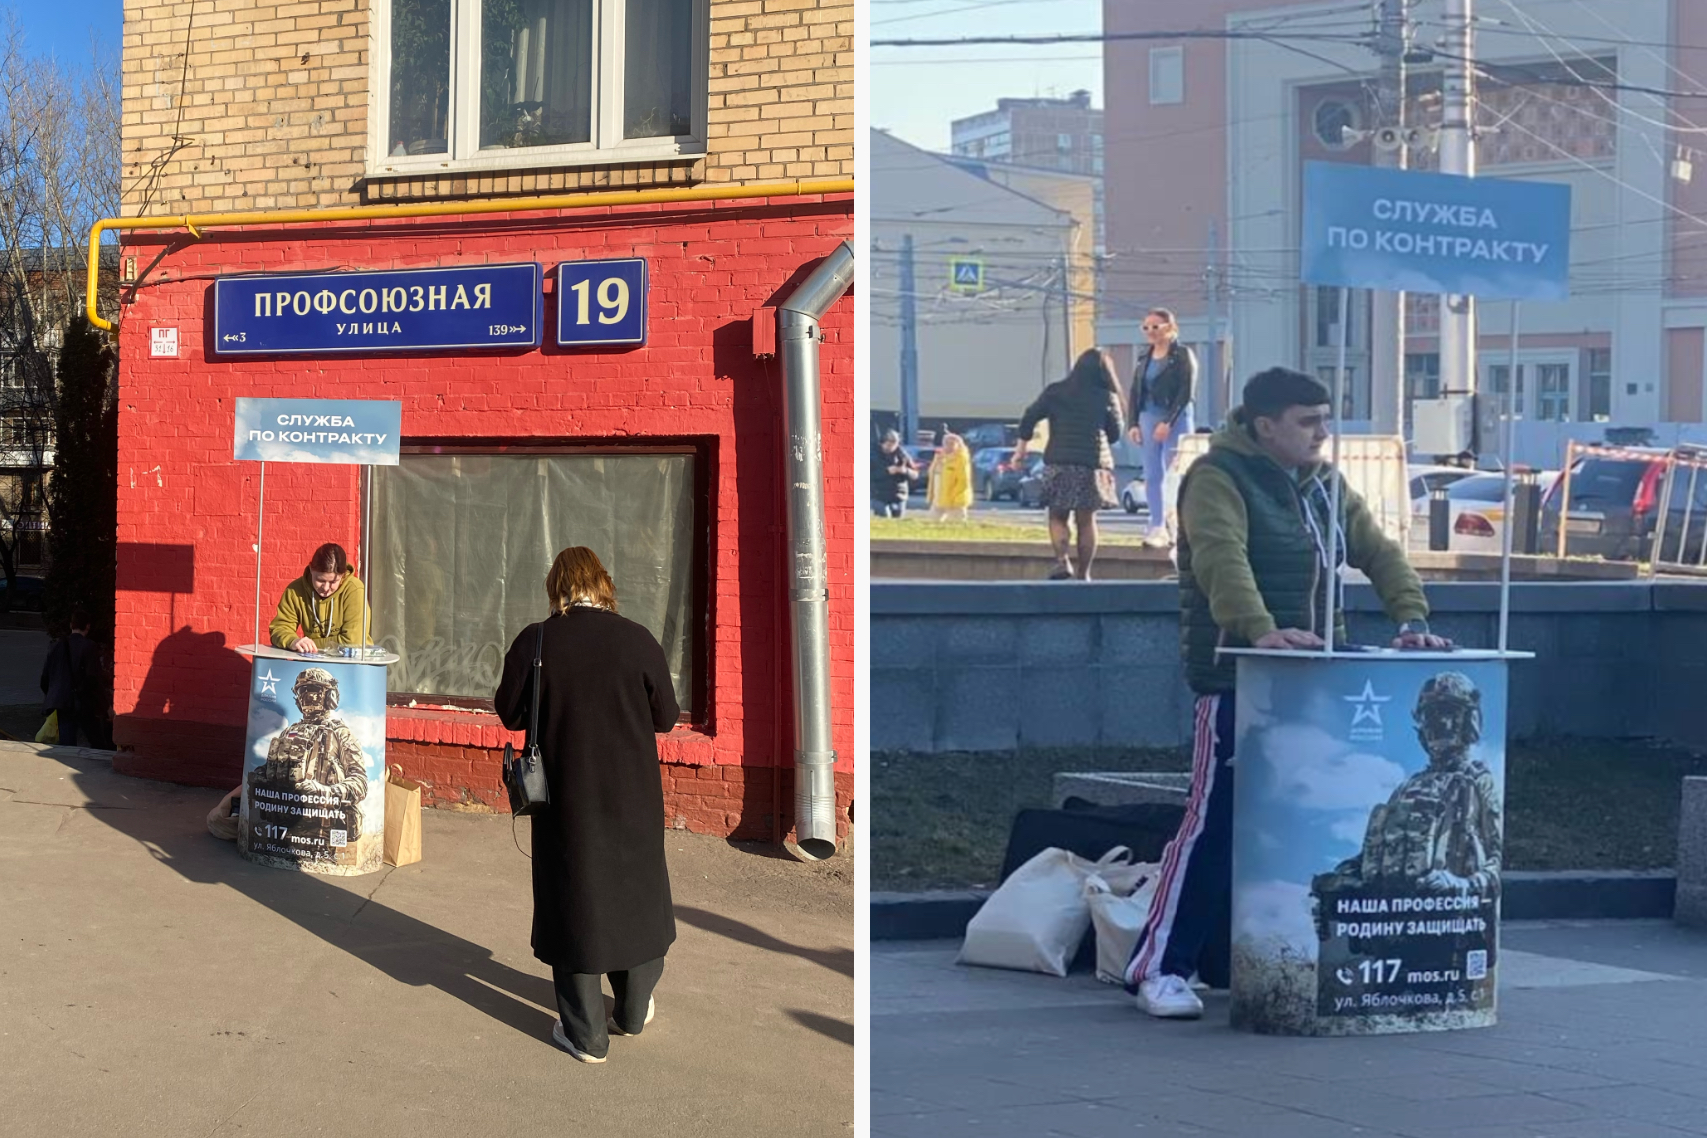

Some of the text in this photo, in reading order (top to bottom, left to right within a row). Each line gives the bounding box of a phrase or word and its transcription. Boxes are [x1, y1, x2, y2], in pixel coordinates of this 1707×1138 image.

[1372, 198, 1499, 229] СЛУЖБА
[1327, 226, 1550, 264] ПО КОНТРАКТУ
[254, 282, 492, 317] ПРОФСОЮЗНАЯ
[571, 277, 631, 325] 19
[159, 329, 170, 338] ПГ
[239, 331, 247, 342] 3
[336, 321, 403, 336] УЛИЦА
[488, 324, 509, 336] 139
[276, 414, 355, 428] СЛУЖБА
[248, 430, 388, 445] ПО КОНТРАКТУ
[255, 788, 280, 799] НАША
[281, 791, 339, 805] ПРОФЕССИЯ
[254, 800, 346, 820] РОДИНУ ЗАЩИЩАТЬ
[264, 824, 325, 846] 117 mos.ru
[1337, 898, 1389, 914] НАША
[1391, 895, 1479, 913] ПРОФЕССИЯ
[1336, 917, 1487, 938] РОДИНУ ЗАЩИЩАТЬ
[1358, 958, 1460, 984] 117 mos.ru
